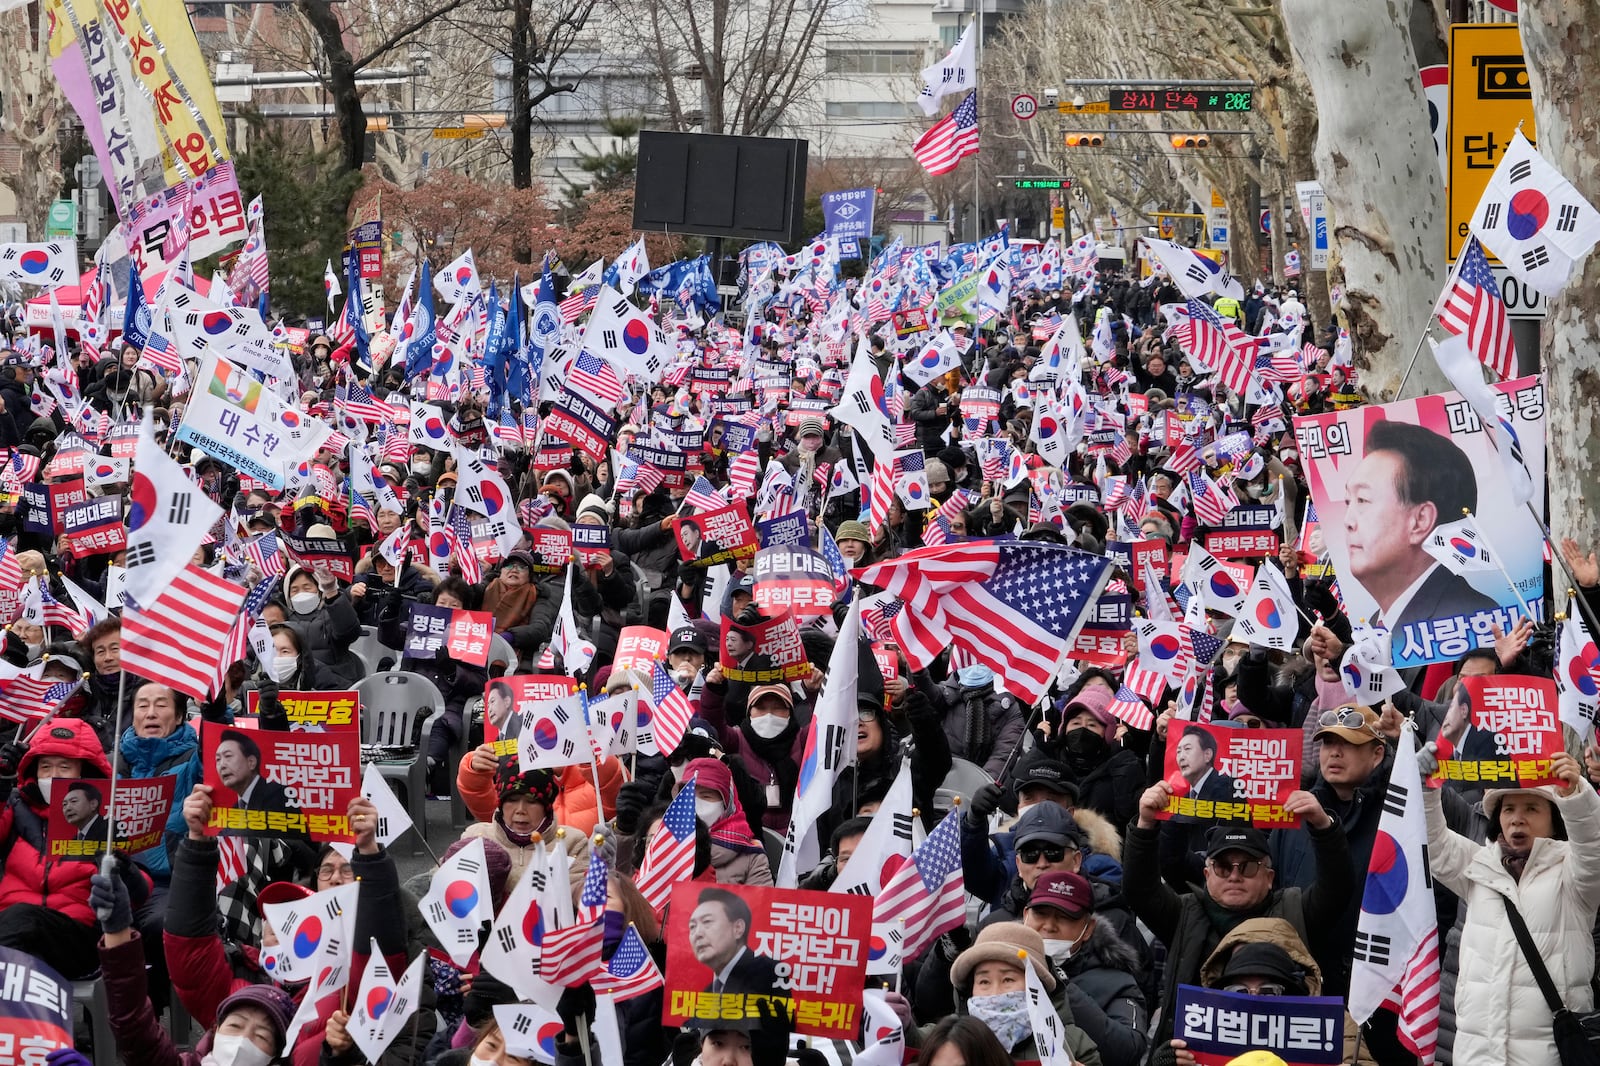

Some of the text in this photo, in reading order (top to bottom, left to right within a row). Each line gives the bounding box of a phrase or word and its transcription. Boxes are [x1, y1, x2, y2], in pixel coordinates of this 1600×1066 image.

[1017, 101, 1033, 114] 30
[1122, 92, 1156, 109] 상시
[1165, 92, 1199, 109] 단속
[1500, 276, 1546, 308] 00
[243, 346, 262, 357] Since
[264, 354, 281, 365] 2020
[826, 342, 846, 350] STOP
[557, 391, 612, 436] 헌법대로!
[792, 400, 829, 410] 헌법대로
[547, 413, 603, 457] 탄핵무효!
[663, 433, 703, 448] 법대로!
[537, 453, 571, 466] 핵무효
[25, 491, 47, 508] 명분
[55, 491, 84, 508] 탄핵
[66, 501, 118, 529] 헌법대로!
[704, 510, 740, 528] 국민이
[770, 517, 800, 533] 국민이
[540, 534, 568, 546] 국민이
[571, 528, 607, 543] 대로!
[703, 519, 749, 543] 지켜보고
[767, 526, 806, 546] 지켜보고
[534, 544, 571, 557] 지켜보고
[716, 535, 743, 550] 있다!
[1209, 536, 1275, 552] 탄핵무효!
[756, 552, 833, 580] 헌법대로!
[1137, 549, 1165, 565] 탄핵
[755, 586, 833, 609] 탄핵무효
[413, 615, 446, 634] 명분
[455, 621, 488, 640] 탄핵
[410, 636, 443, 651] 실종
[451, 639, 485, 655] 무효
[621, 636, 661, 657] 탄핵
[1073, 635, 1126, 657] 무효!
[770, 649, 802, 668] 있다!
[785, 662, 813, 679] 복귀
[523, 683, 569, 699] 국민이
[1483, 687, 1545, 710] 국민이
[255, 699, 355, 726] 핵무효
[1476, 710, 1556, 732] 지켜보고
[274, 742, 340, 766] 국민이
[488, 738, 518, 757] 통령
[1229, 738, 1287, 759] 국민이
[1494, 732, 1543, 755] 있다!
[265, 764, 352, 788] 지켜보고
[1218, 758, 1294, 780] 지켜보고
[1480, 760, 1517, 782] 즉각
[115, 785, 163, 803] 국민이
[284, 787, 335, 809] 있다!
[1233, 779, 1279, 800] 있다!
[104, 799, 167, 821] 지켜보고
[208, 807, 267, 830] 대통령
[267, 811, 308, 834] 즉각
[1215, 801, 1250, 822] 즉각
[116, 817, 154, 838] 있다!
[52, 840, 99, 856] 대통령
[770, 902, 850, 937] 국민이
[754, 931, 860, 967] 지켜보고
[772, 962, 836, 995] 있다!
[0, 961, 68, 1020] 대로!
[671, 990, 744, 1020] 대통령
[797, 1000, 856, 1031] 복귀!
[1183, 1003, 1335, 1052] 헌법대로!
